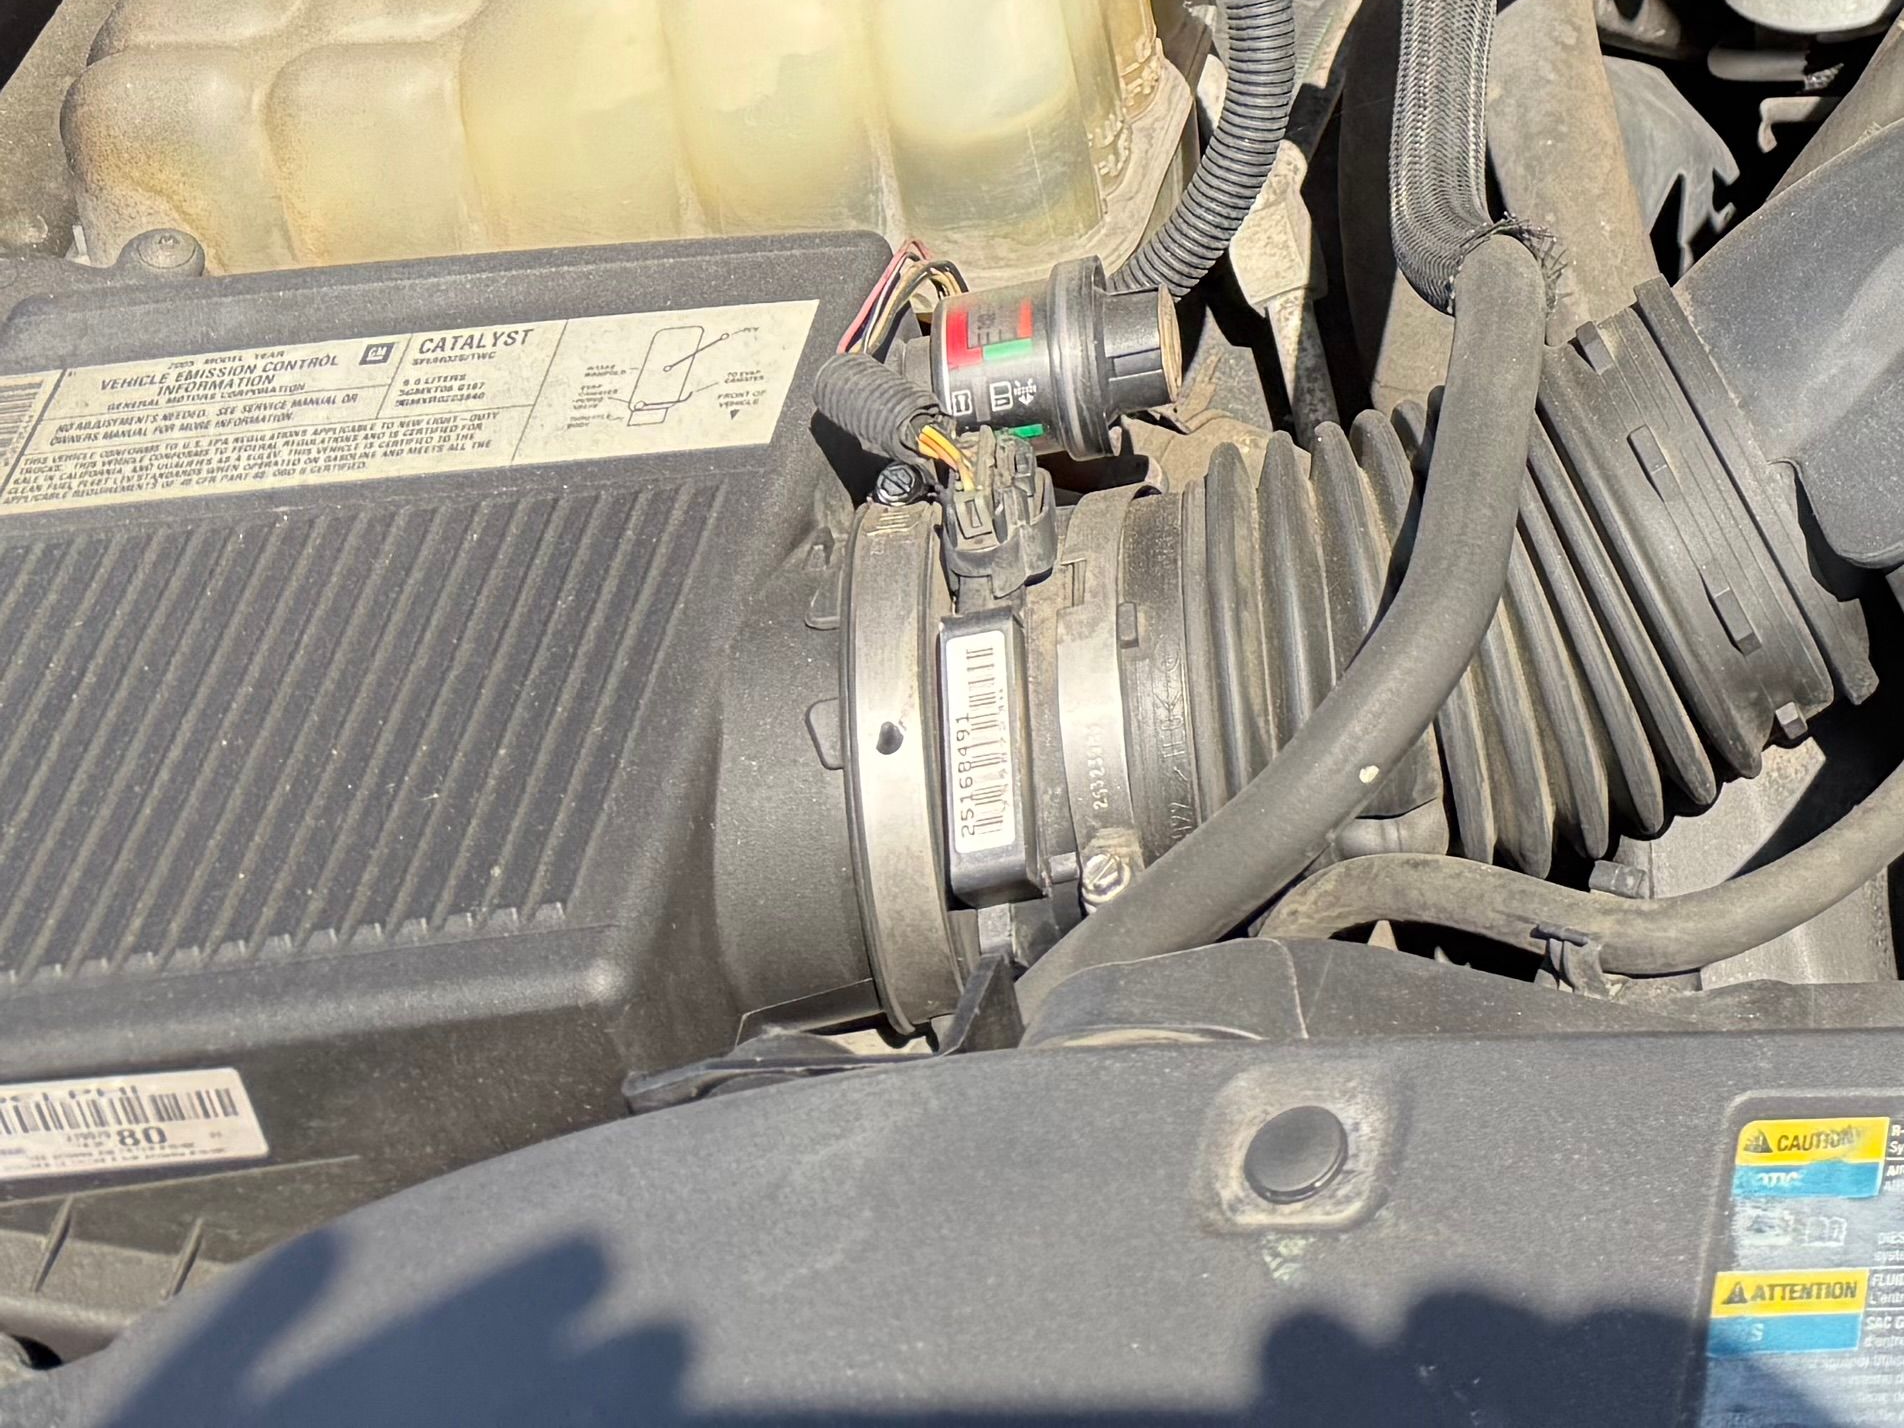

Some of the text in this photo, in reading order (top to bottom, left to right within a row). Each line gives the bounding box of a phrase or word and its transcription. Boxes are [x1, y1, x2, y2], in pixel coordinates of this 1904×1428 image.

[367, 346, 388, 361] GM
[419, 328, 534, 355] CATALYST
[100, 354, 340, 391] VEHICLE EMISSION CONTROL
[157, 374, 276, 397] INFORMATION
[424, 373, 467, 385] LITERS
[106, 383, 306, 412] GENERAL MOTORS CORPORATION
[718, 390, 750, 400] FRONT
[718, 397, 760, 409] VEHICLE
[75, 393, 359, 432] ADJUSTMENTS SEE SERVICE MANUAL OR
[52, 452, 96, 465] VEHICLE
[99, 444, 161, 459] CONFORMS
[232, 429, 308, 445] REGULATIONS
[312, 422, 377, 437] APPLICABLE
[398, 418, 423, 429] NEW
[101, 456, 146, 469] VEHICLE
[148, 449, 211, 463] CONFORMS
[236, 442, 278, 454] FEDERAL
[281, 433, 359, 450] REGULATIONS
[362, 432, 386, 443] AND
[402, 425, 458, 438] CERTIFIED
[461, 422, 484, 432] FOR
[102, 427, 149, 441] MANUAL
[152, 424, 177, 435] FOR
[131, 463, 153, 474] AND
[156, 457, 213, 471] QUALIFIES
[316, 443, 362, 456] VEHICLE
[377, 437, 434, 450] CERTIFIED
[455, 432, 476, 443] THE
[7, 439, 493, 496] CLEAN FUEL FLEET STANDARDS WHEN OPERATED ON GASOLINE AND MEETS ALL THE
[3, 491, 68, 505] APPLICABLE
[72, 481, 159, 499] REQUIREMENTS
[219, 472, 249, 483] PART
[956, 713, 976, 838] 25168491
[116, 1125, 168, 1147] 80
[1777, 1126, 1858, 1153] CAUTION
[1750, 1281, 1858, 1302] ATTENTION
[1865, 1315, 1892, 1331] SAC
